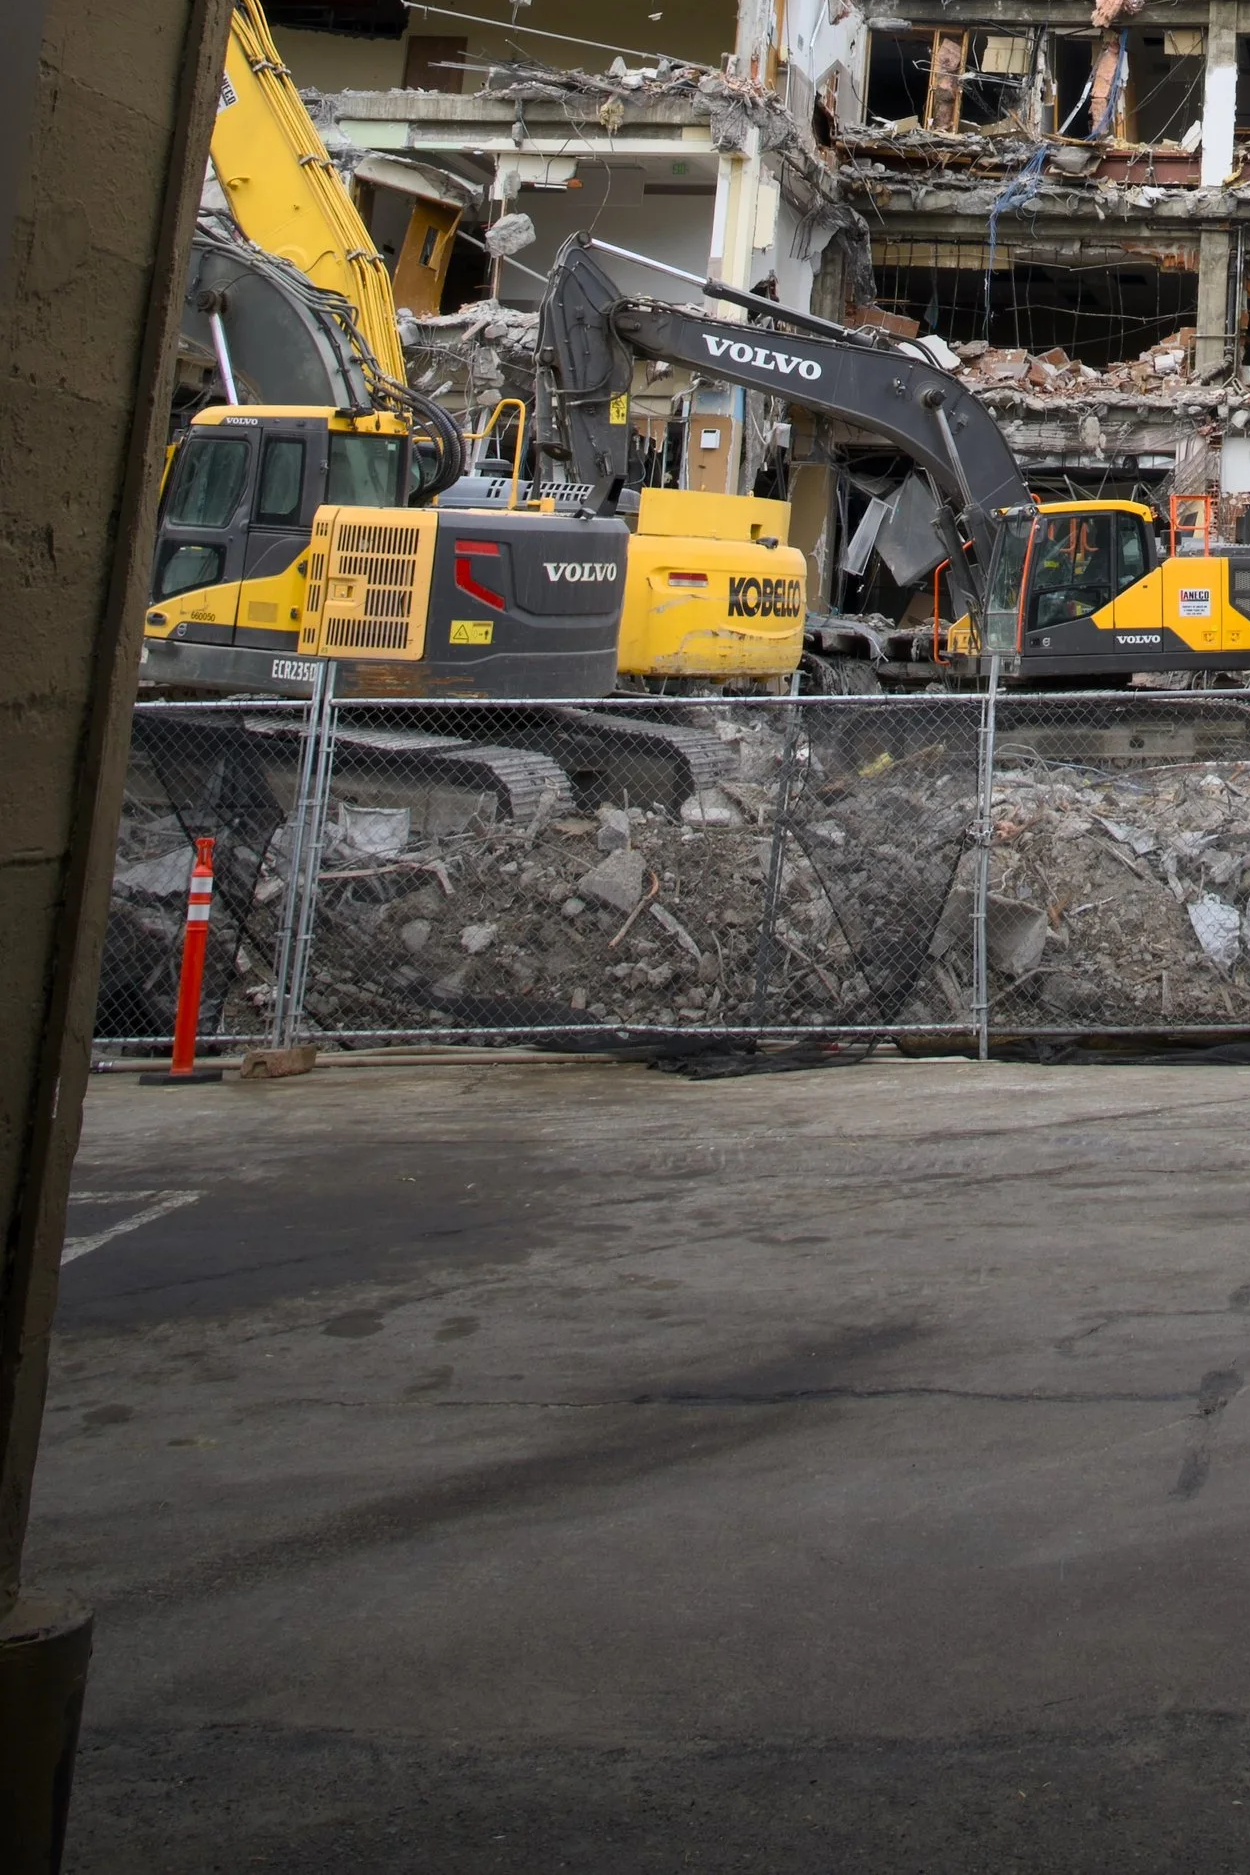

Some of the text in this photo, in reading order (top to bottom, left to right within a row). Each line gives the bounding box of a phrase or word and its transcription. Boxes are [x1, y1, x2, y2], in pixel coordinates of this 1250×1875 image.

[702, 333, 822, 380] VOLVO
[226, 417, 258, 425] VOLVO
[543, 562, 618, 582] VOLVO
[728, 576, 800, 618] KOBELCO
[1116, 634, 1161, 644] VOLVO
[272, 659, 319, 682] ECR235D
